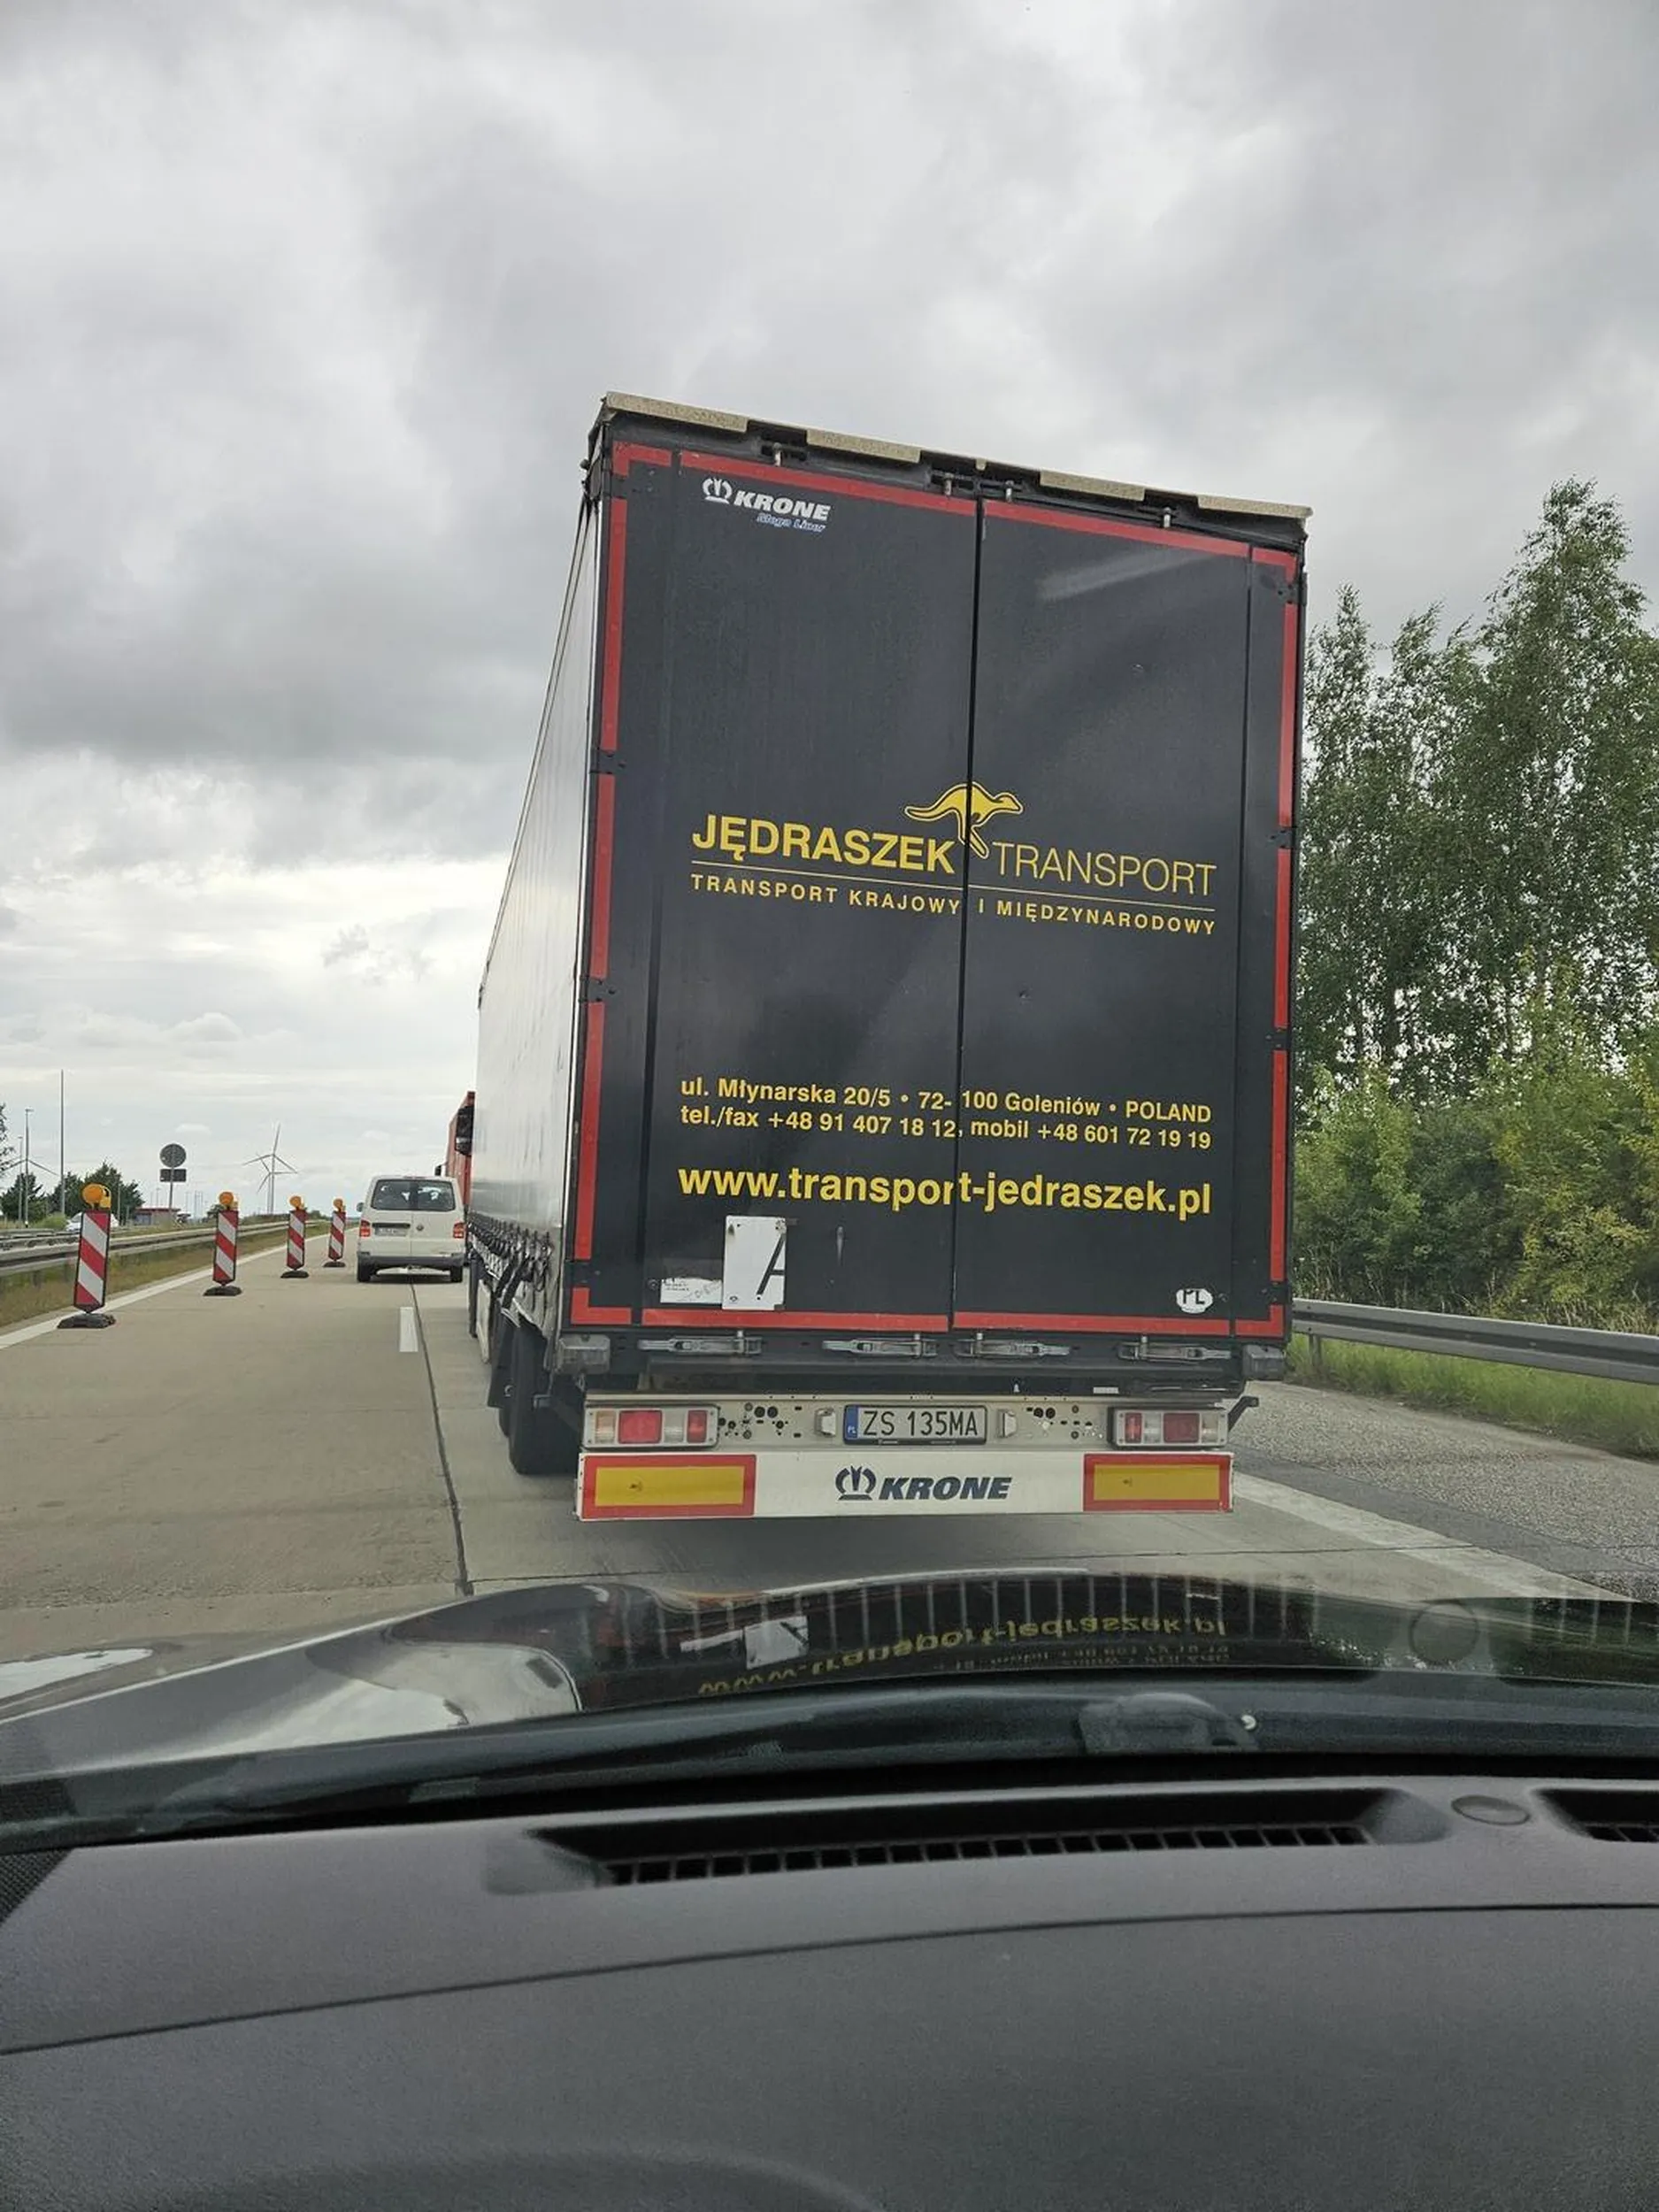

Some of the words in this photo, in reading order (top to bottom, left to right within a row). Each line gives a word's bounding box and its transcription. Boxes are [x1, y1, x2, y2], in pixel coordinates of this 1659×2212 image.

[733, 489, 832, 522] KRONE
[691, 813, 956, 876] JĘDRASZEK
[991, 841, 1217, 897] TRANSPORT
[690, 872, 839, 904] TRANSPORT
[849, 888, 961, 917] KRAJOWY
[978, 897, 985, 915] I
[996, 899, 1216, 936] MIĘDZYNARODOWY
[680, 1077, 710, 1097] ul.
[718, 1077, 837, 1105] Młynarska
[843, 1087, 891, 1109] 20/5
[1004, 1091, 1101, 1118] Goleniów
[1125, 1099, 1212, 1124] POLAND
[680, 1104, 759, 1128] tel./fax
[767, 1110, 813, 1133] +48
[819, 1112, 844, 1133] 91
[852, 1115, 893, 1135] 407
[901, 1118, 926, 1137] 18
[970, 1118, 1030, 1139] mobil
[1037, 1122, 1079, 1142] +48
[1084, 1124, 1119, 1144] 601
[1127, 1126, 1151, 1147] 72
[1158, 1129, 1182, 1148] 19
[1187, 1131, 1212, 1150] 19
[677, 1166, 1212, 1223] www.transport-jedraszek.pl
[863, 1410, 895, 1436] ZS
[907, 1410, 979, 1437] 135MA
[878, 1475, 1013, 1502] KRONE
